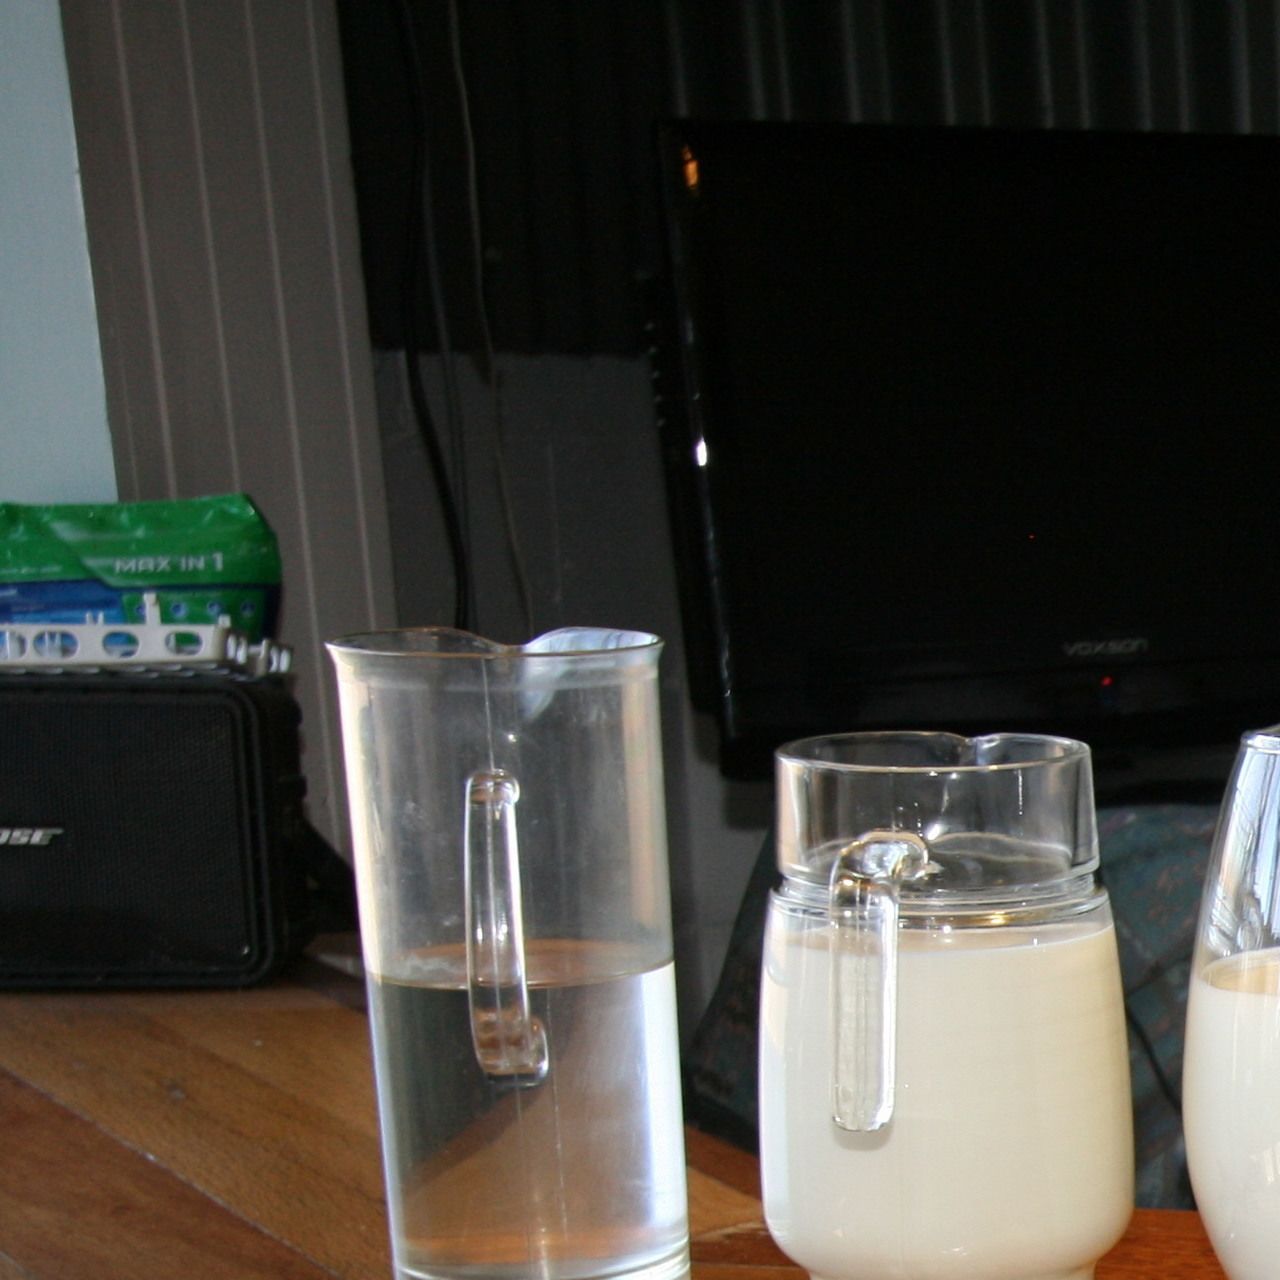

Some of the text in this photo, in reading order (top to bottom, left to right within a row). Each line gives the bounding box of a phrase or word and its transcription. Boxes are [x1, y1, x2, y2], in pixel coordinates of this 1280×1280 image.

[114, 552, 224, 573] MAX IN 1
